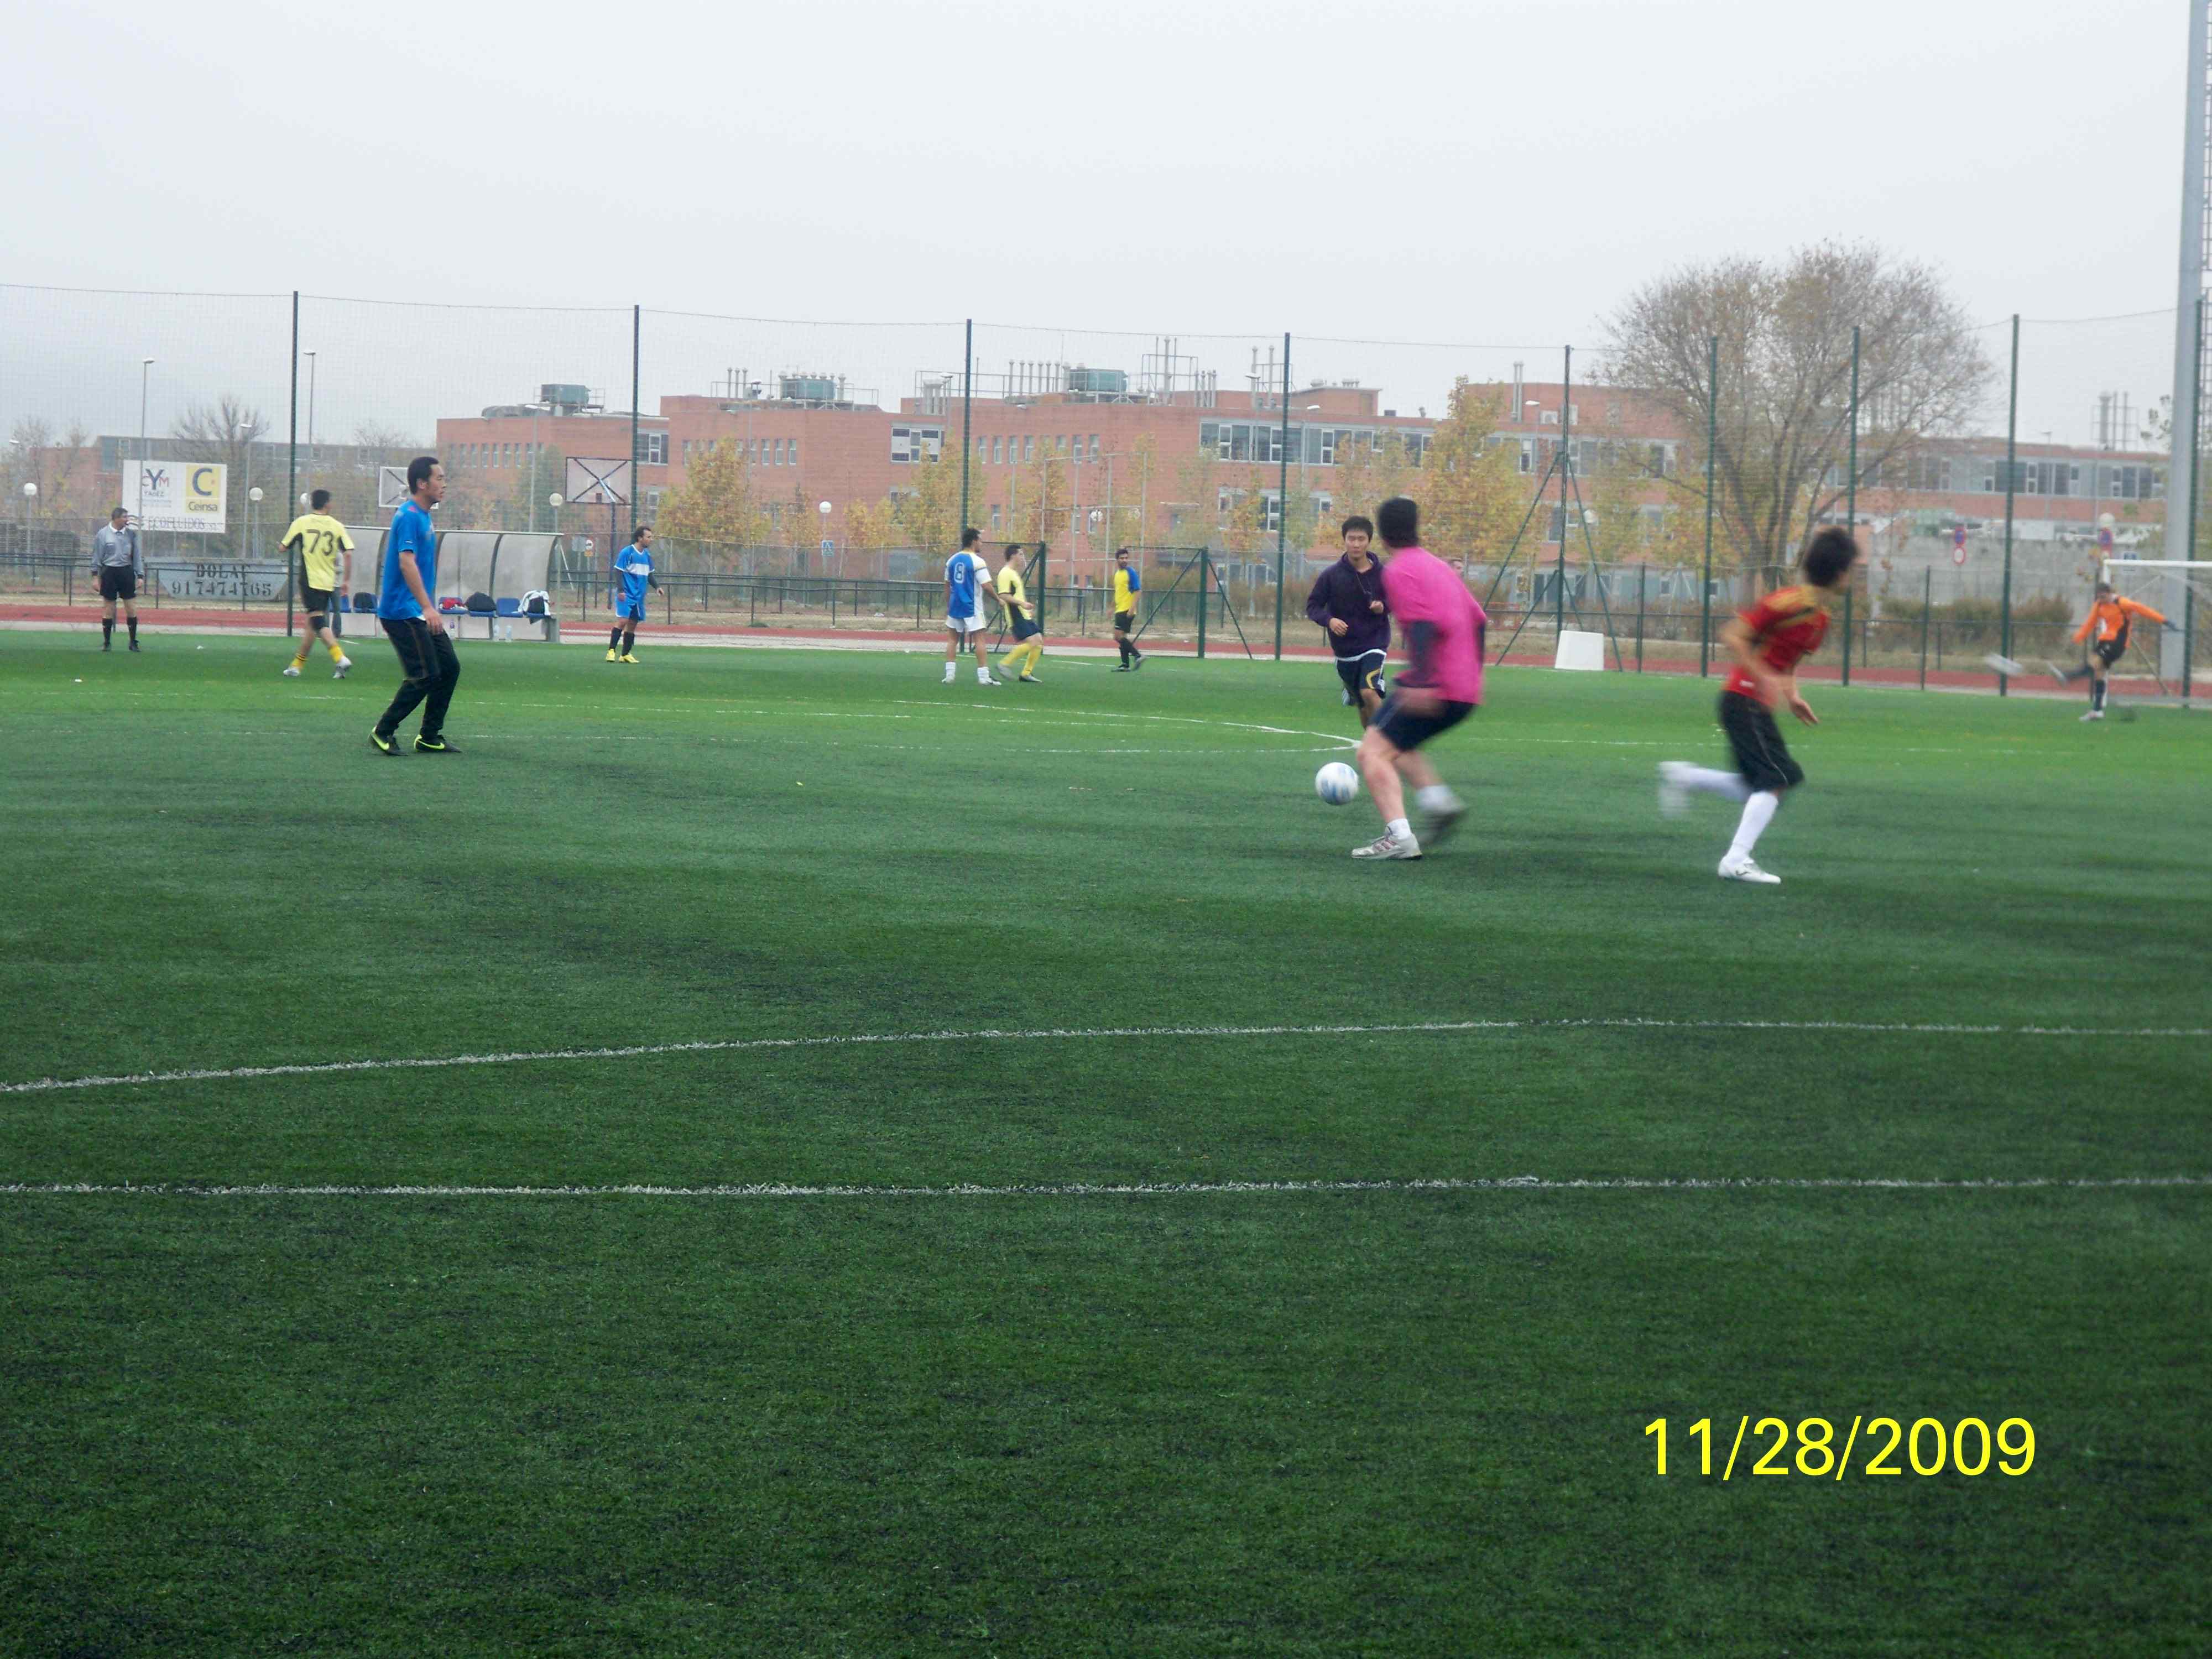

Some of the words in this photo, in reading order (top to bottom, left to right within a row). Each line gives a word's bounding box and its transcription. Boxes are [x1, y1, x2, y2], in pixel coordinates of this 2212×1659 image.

[188, 502, 218, 512] Ceinsa
[306, 529, 334, 556] 73
[954, 562, 964, 584] 8
[172, 579, 272, 597] 917474765
